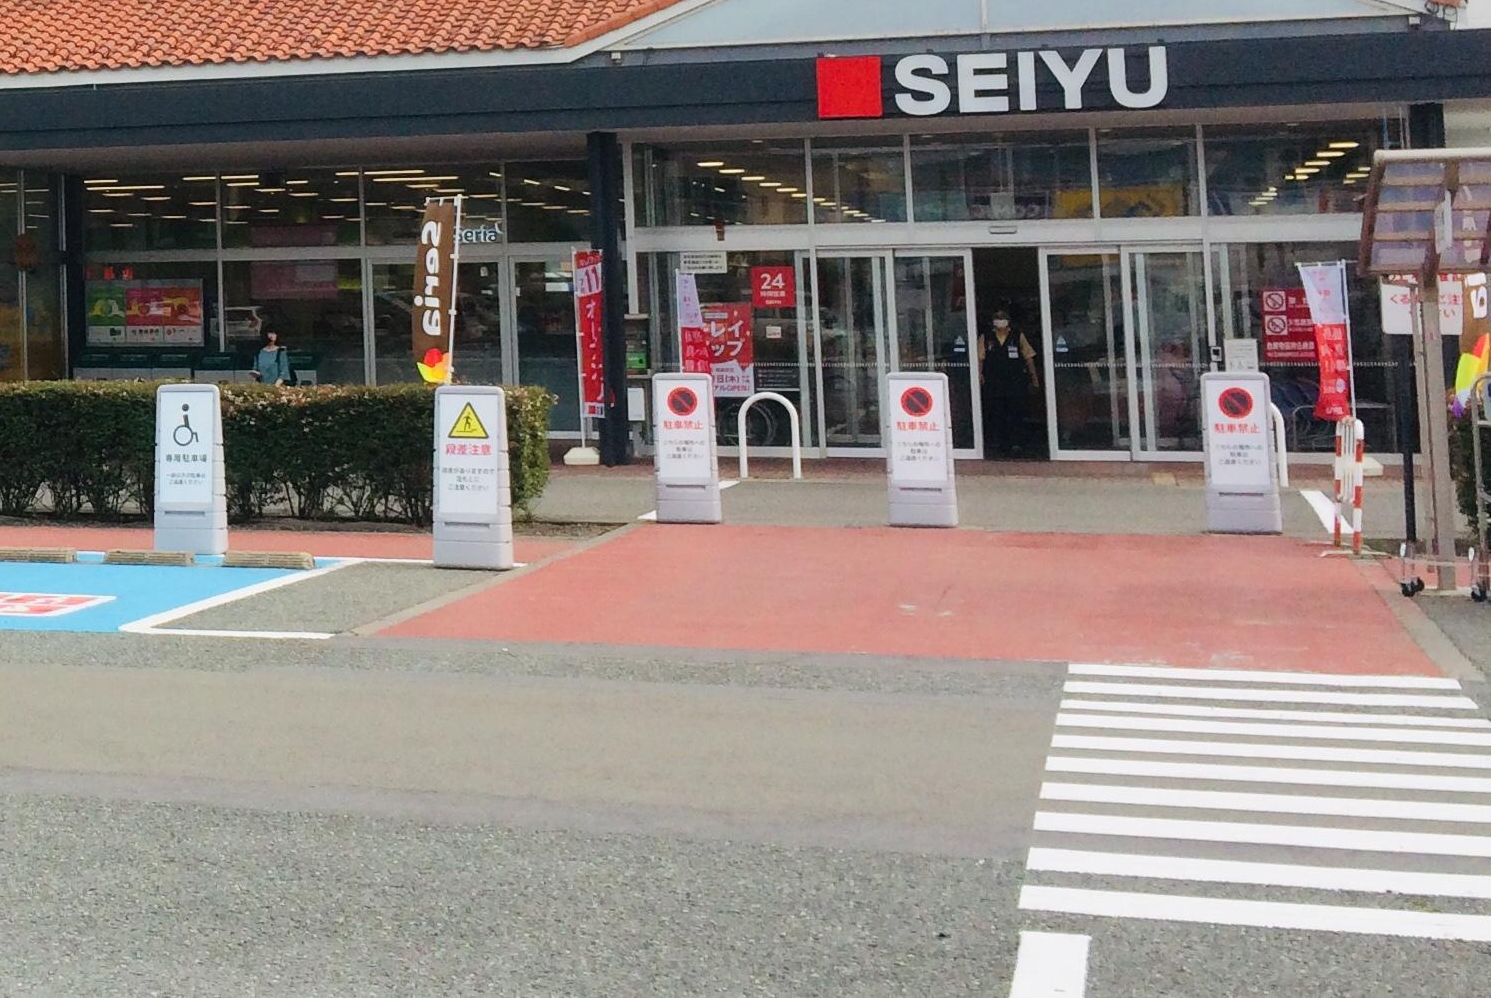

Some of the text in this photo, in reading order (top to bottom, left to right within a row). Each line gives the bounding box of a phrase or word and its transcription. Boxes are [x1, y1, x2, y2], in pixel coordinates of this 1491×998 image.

[894, 46, 1169, 116] SEIYU
[760, 272, 786, 290] 24
[663, 420, 703, 430] 駐車禁止
[896, 421, 940, 431] 駐車禁止
[1214, 423, 1261, 433] 駐車禁止
